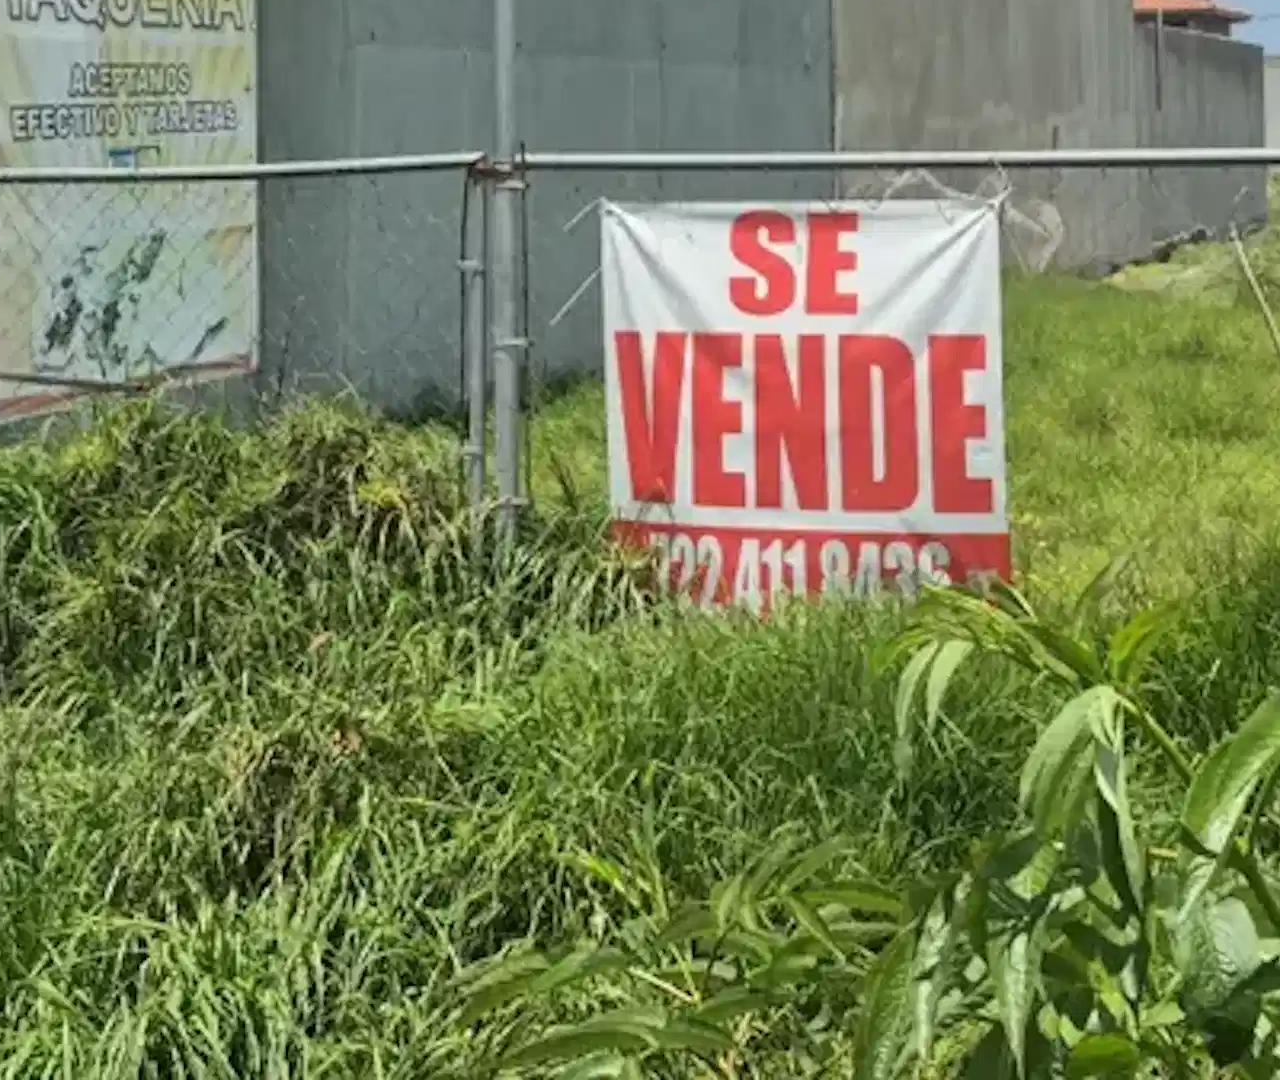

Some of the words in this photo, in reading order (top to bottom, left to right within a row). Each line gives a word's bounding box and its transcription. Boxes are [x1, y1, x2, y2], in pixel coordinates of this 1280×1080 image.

[67, 61, 193, 97] ACEPTAMOS
[10, 103, 120, 142] EFECTIVO
[122, 101, 141, 137] Y
[142, 98, 238, 135] TARJETAS
[728, 208, 860, 317] SE
[614, 330, 995, 515] VENDE
[732, 537, 808, 616] 411
